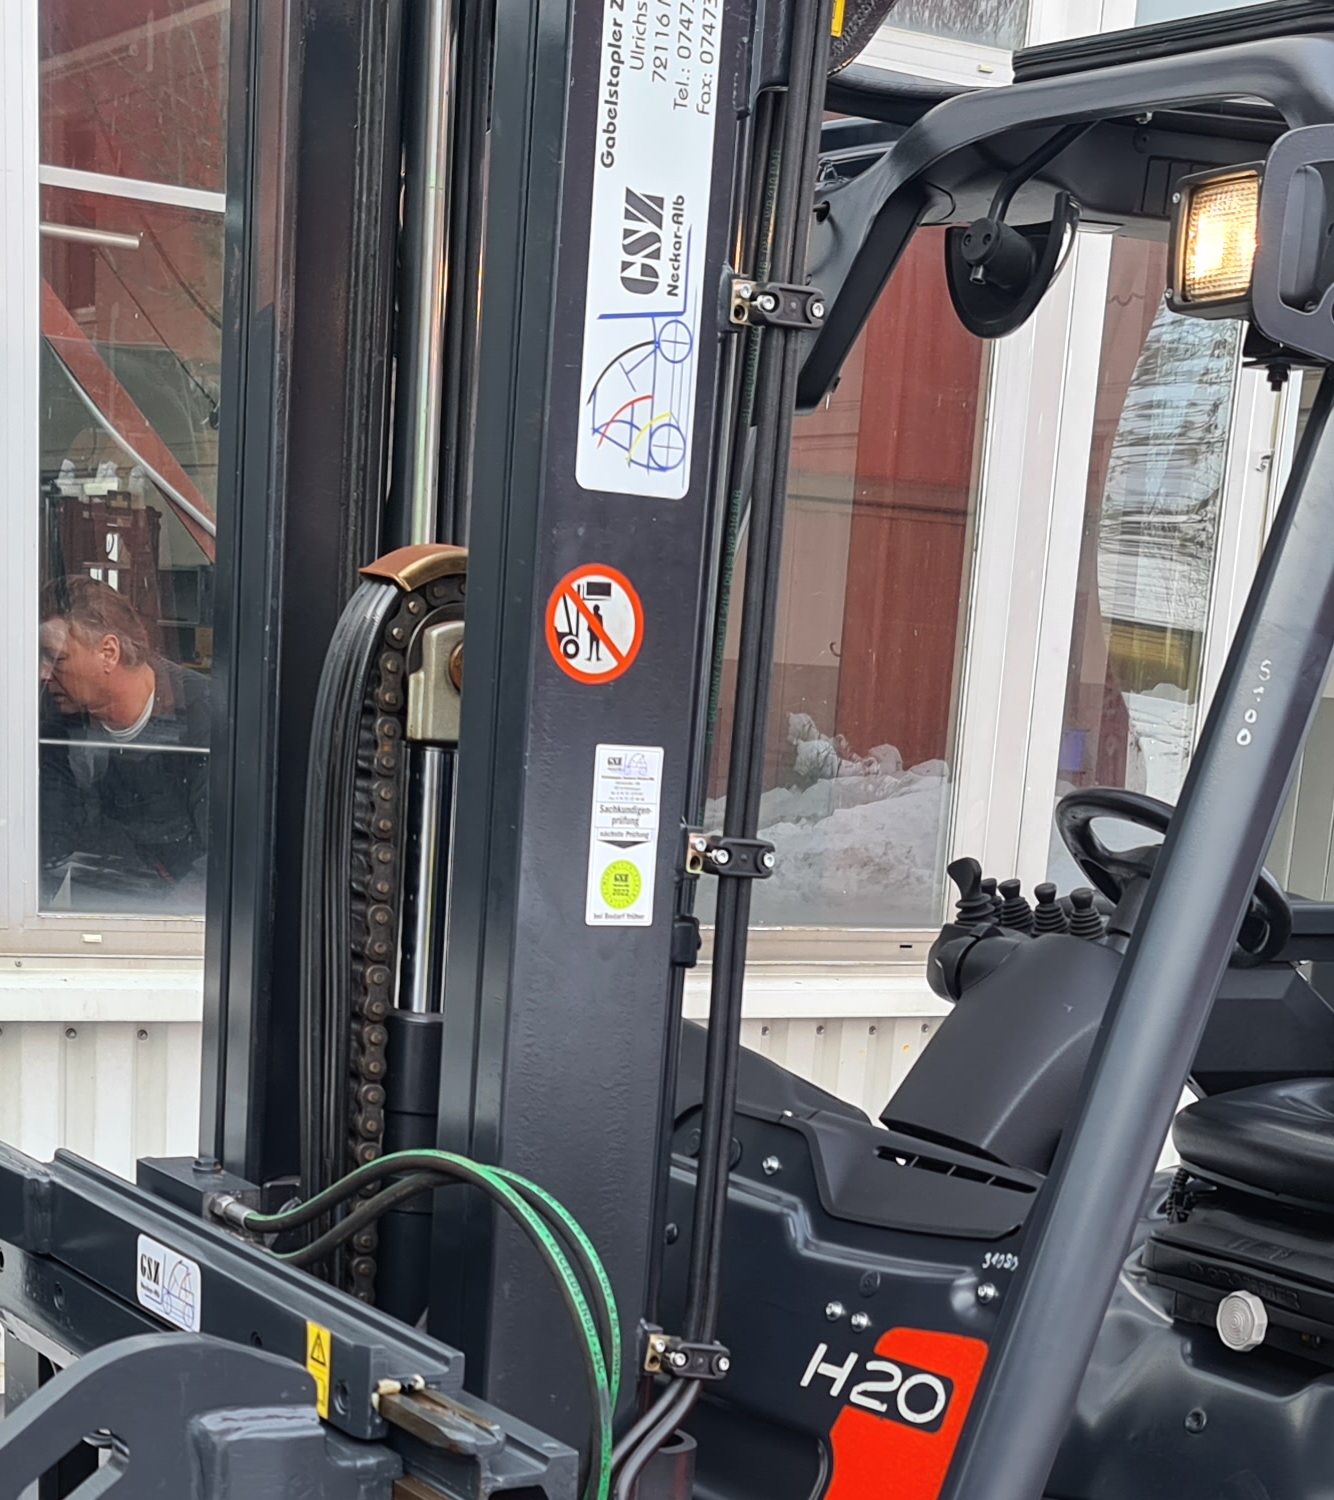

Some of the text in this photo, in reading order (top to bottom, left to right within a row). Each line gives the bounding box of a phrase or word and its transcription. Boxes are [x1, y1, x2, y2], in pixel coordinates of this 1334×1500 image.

[601, 17, 625, 169] Gabelstapler
[652, 13, 671, 83] 72116
[673, 0, 695, 111] Tel.: 0747
[696, 73, 713, 115] Fax:
[619, 186, 665, 295] GSZ
[666, 195, 685, 298] Neckar-Alb
[708, 671, 721, 722] GERMANY
[722, 570, 732, 585] DN
[549, 1242, 583, 1297] EXCEEDS
[799, 1341, 947, 1425] H20
